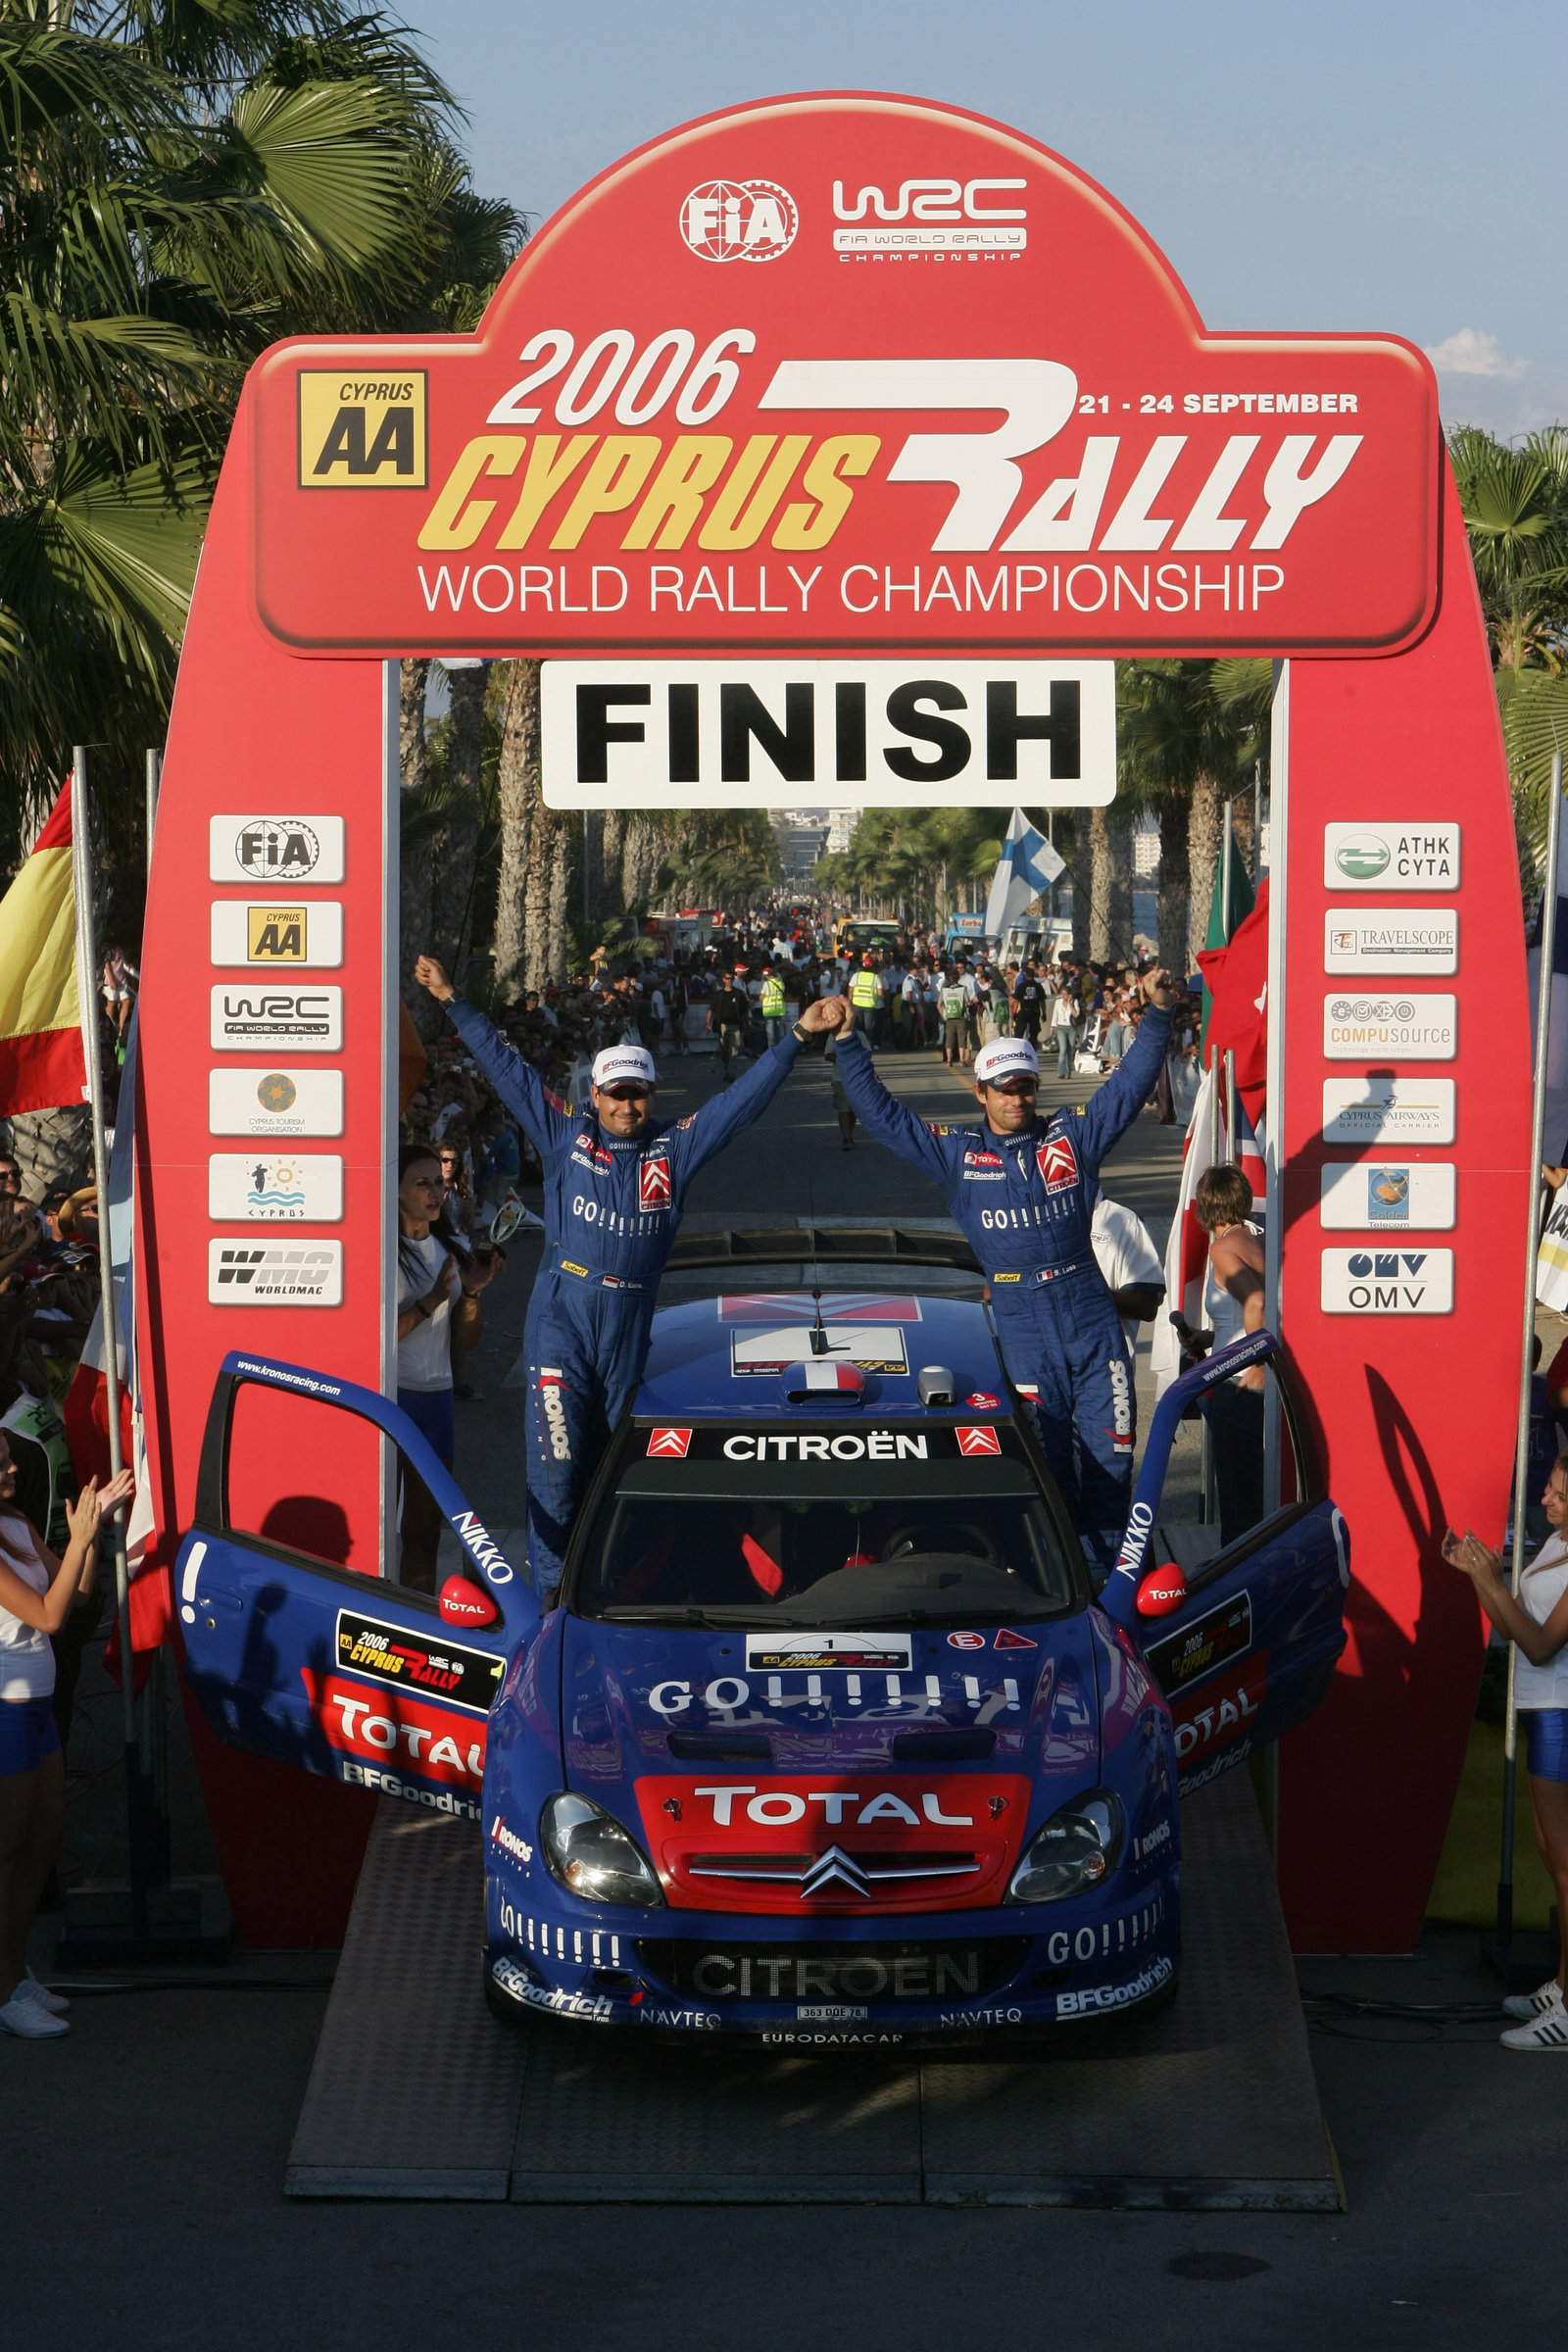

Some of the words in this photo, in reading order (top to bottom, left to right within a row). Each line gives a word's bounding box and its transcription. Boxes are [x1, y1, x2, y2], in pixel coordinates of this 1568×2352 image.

[833, 178, 1027, 220] WRC
[839, 234, 868, 245] FIA
[874, 234, 944, 245] WORLD
[952, 234, 1021, 245] RALLY
[839, 253, 1021, 263] CHAMPIONSHIP
[485, 327, 757, 426] 2006
[339, 381, 415, 401] CYPRUS
[1078, 394, 1108, 415] 21
[1140, 394, 1175, 414] 24
[1183, 393, 1358, 414] SEPTEMBER
[312, 406, 414, 475] AA
[416, 433, 882, 551] CYPRUS
[758, 358, 1364, 552] RALLY
[416, 564, 628, 612] WORLD
[649, 564, 823, 612] RALLY
[840, 564, 1286, 612] CHAMPIONSHIP
[575, 679, 1082, 784] FINISH
[1397, 837, 1450, 855] ATHK
[1397, 858, 1450, 876] CYTA
[267, 912, 301, 922] CYPRUS
[254, 923, 301, 956] AA
[1361, 929, 1453, 945] TRAVELSCOPE
[224, 996, 329, 1018] WRC
[248, 1117, 274, 1126] CYPRUS
[275, 1117, 306, 1126] TOURISM
[1340, 1111, 1382, 1121] CYPRUS
[1386, 1111, 1440, 1121] AIRWAYS
[255, 1286, 323, 1296] WORLDMAC
[1348, 1286, 1426, 1308] OMV
[1201, 1339, 1268, 1383] www.kronosracing.com
[236, 1358, 342, 1396] www.kronosracing.com
[722, 1430, 928, 1461] CITROËN
[452, 1510, 514, 1585] NIKKO
[1116, 1501, 1153, 1581] NIKKO
[1149, 1587, 1188, 1600] TOTAL
[443, 1598, 486, 1614] TOTAL
[357, 1631, 390, 1651] 2006
[823, 1639, 834, 1649] 1
[955, 1635, 978, 1646] E
[349, 1643, 405, 1674] CYPRUS
[389, 1644, 462, 1690] RALLY
[777, 1658, 837, 1667] CYPRUS
[1174, 1687, 1259, 1759] OTAL
[333, 1693, 485, 1778] TOTAL
[1177, 1739, 1253, 1799] Goodrich
[343, 1760, 482, 1822] BFGoodri
[694, 1786, 974, 1827] TOTAL
[693, 1945, 979, 1997] CITROËN
[491, 1955, 614, 2016] BFGoodrich
[1055, 1955, 1173, 2017] BFGoodrich
[640, 2007, 722, 2030] NAVTEQ
[805, 2008, 822, 2017] 363
[851, 2008, 861, 2017] 78
[940, 2007, 1022, 2029] NAVTEQ
[761, 2034, 903, 2043] EURODATACAR
